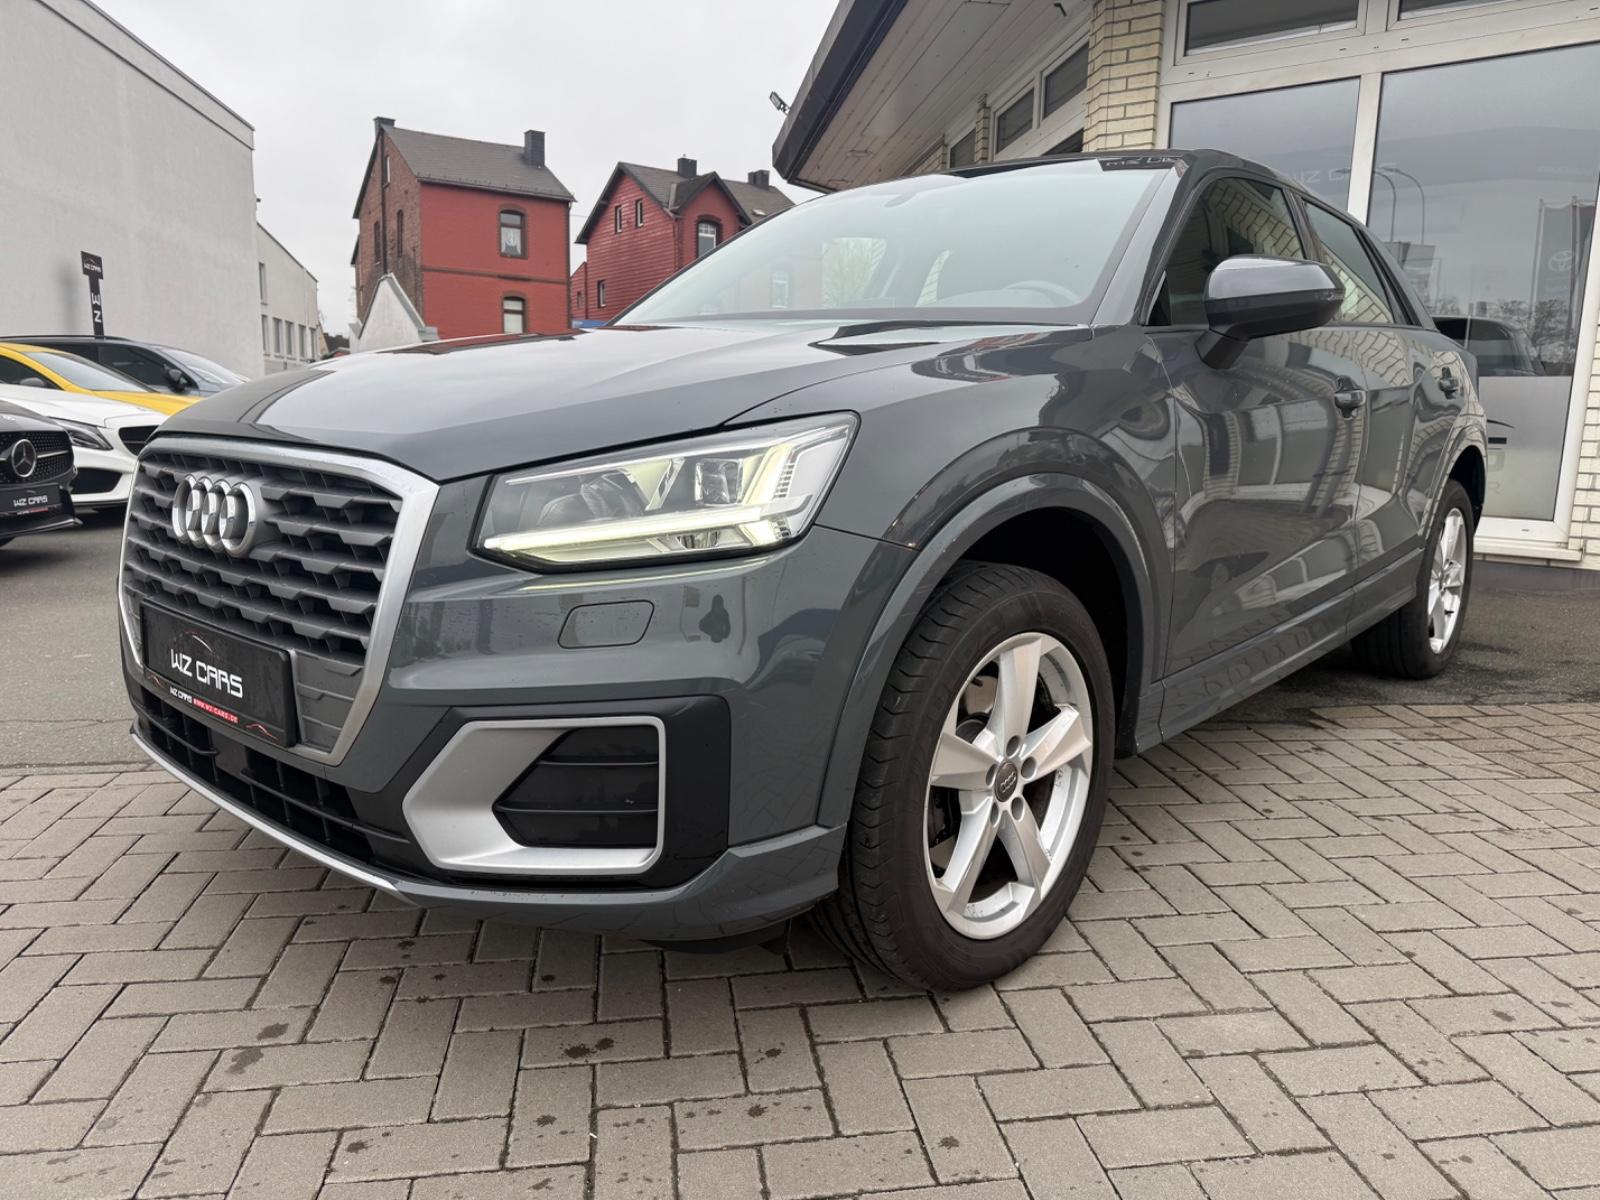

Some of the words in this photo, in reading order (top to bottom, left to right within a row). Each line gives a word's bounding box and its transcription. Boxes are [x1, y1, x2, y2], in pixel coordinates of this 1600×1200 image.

[13, 498, 27, 507] WZ
[28, 495, 48, 505] CARS
[170, 648, 192, 677] WZ
[195, 660, 243, 698] CARS
[170, 686, 178, 697] WZ
[178, 691, 192, 703] CARS
